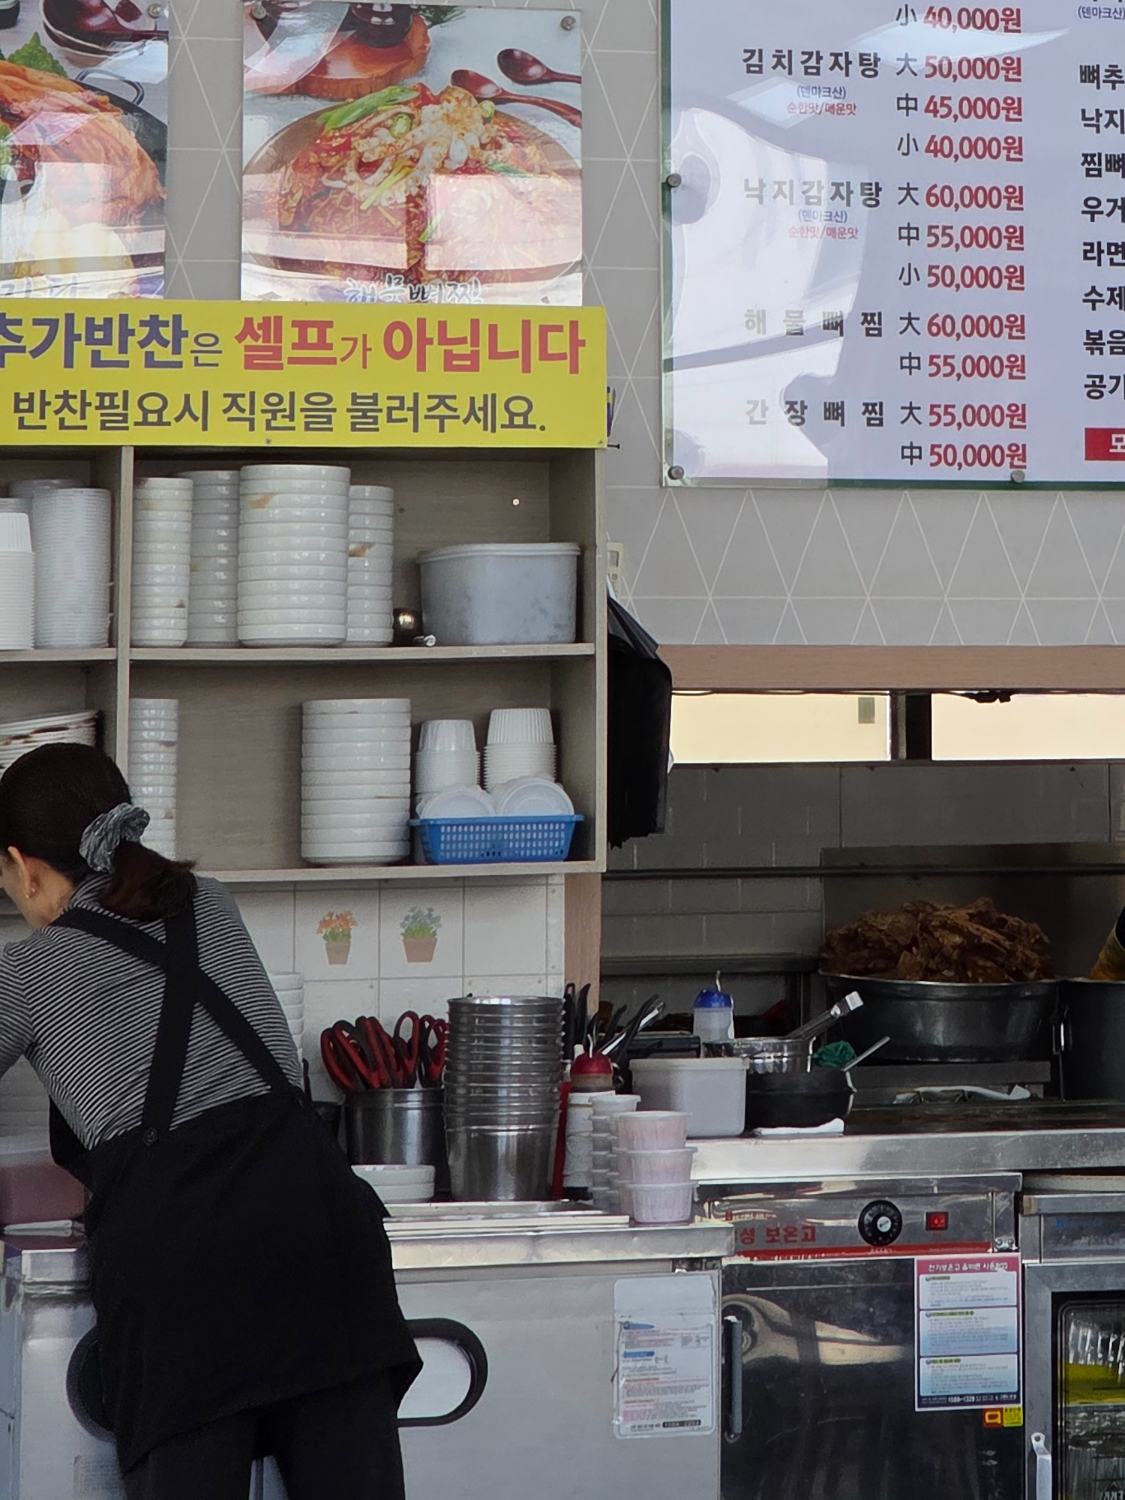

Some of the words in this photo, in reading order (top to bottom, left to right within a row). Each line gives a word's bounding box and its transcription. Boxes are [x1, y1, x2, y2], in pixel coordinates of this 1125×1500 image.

[895, 3, 917, 27] 小
[923, 7, 1021, 34] 40,000원
[742, 48, 881, 78] 김치감자탕
[895, 53, 918, 78] 大
[924, 55, 1022, 83] 50,000원
[787, 102, 857, 116] 순한맛/매운맛
[896, 92, 918, 117] 中
[924, 95, 1023, 123] 45,000원
[897, 133, 919, 156] 小
[925, 135, 1024, 162] 40,000원
[743, 178, 882, 208] 낙지감자탕
[897, 182, 919, 207] 大
[925, 184, 1024, 212] 60,000원
[898, 221, 920, 246] 中
[926, 224, 1025, 252] 55,000원
[898, 262, 920, 286] 小
[927, 264, 1025, 291] 50,000원
[744, 308, 767, 335] 해
[783, 310, 806, 336] 물
[822, 310, 844, 337] 뼈
[860, 311, 883, 338] 찜
[899, 311, 921, 336] 大
[927, 313, 1026, 341] 60,000원
[234, 315, 372, 371] 셀프가
[383, 317, 586, 374] 아닙니다
[900, 351, 921, 376] 中
[928, 353, 1026, 381] 55,000원
[13, 389, 209, 432] 반찬필요시
[222, 391, 337, 432] 직원을
[346, 392, 546, 434] 불러주세요.
[745, 399, 768, 425] 간
[784, 400, 807, 427] 장
[823, 400, 845, 427] 뼈
[861, 401, 884, 427] 찜
[900, 401, 922, 426] 大
[929, 402, 1027, 430] 55,000원
[901, 442, 922, 467] 中
[929, 443, 1027, 471] 50,000원
